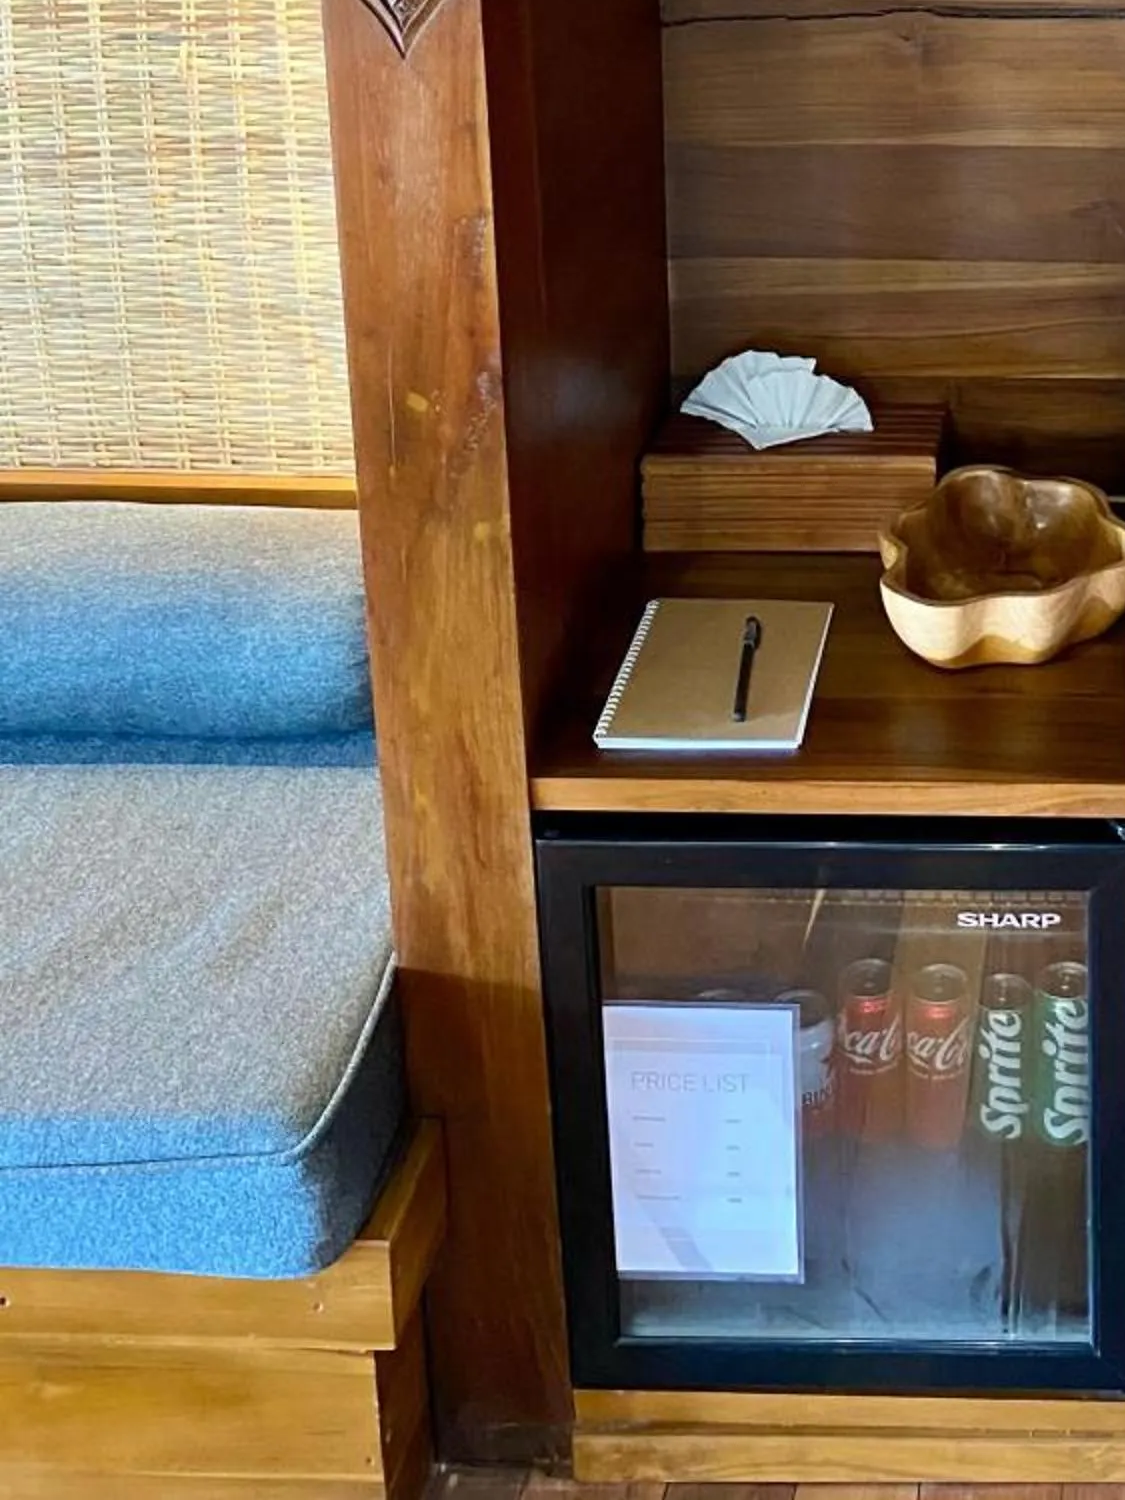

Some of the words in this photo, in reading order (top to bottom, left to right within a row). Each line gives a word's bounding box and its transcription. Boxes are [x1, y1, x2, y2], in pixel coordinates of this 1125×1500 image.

[957, 912, 1061, 929] SHARP
[631, 1071, 698, 1093] PRICE
[703, 1073, 750, 1095] LIST
[979, 1009, 1030, 1140] Sprite
[1042, 998, 1090, 1146] Sprite
